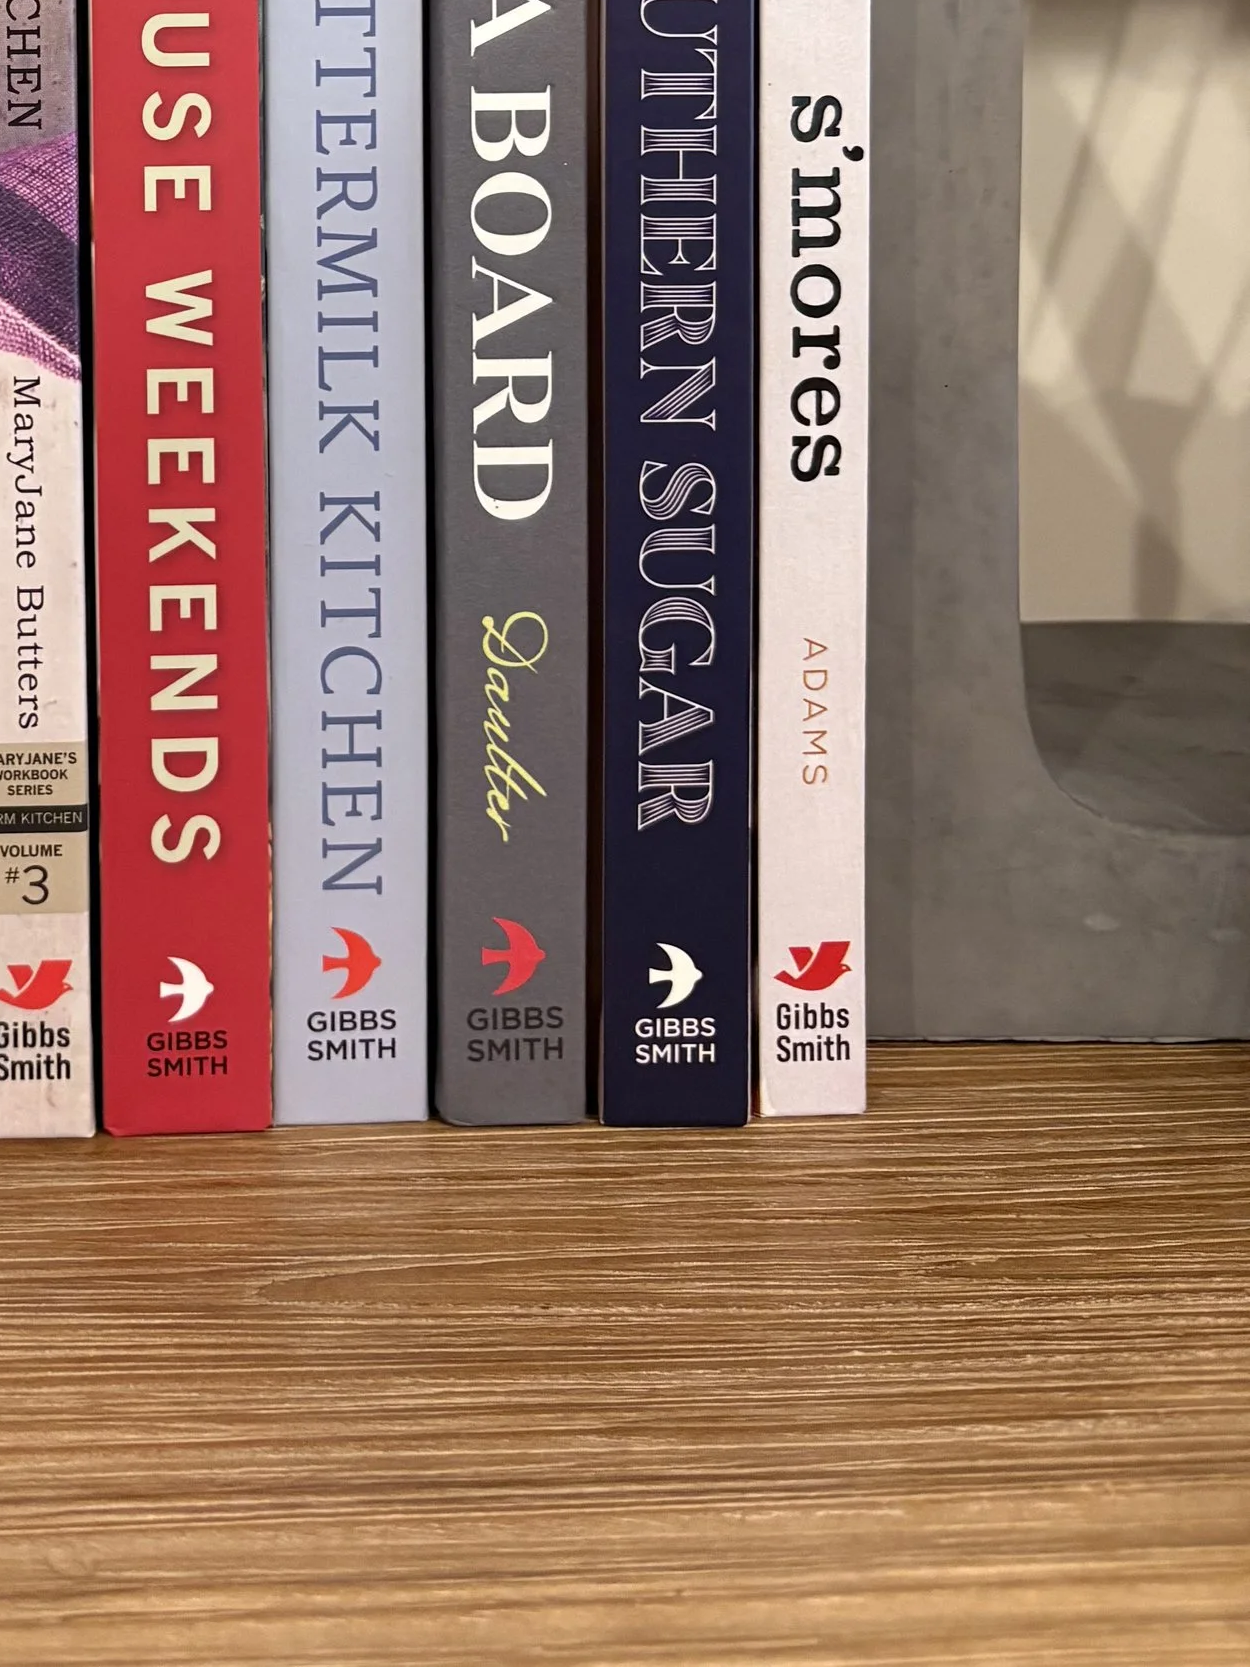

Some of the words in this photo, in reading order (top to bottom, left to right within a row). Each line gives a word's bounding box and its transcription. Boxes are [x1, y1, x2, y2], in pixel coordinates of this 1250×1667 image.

[470, 85, 553, 520] BOARD
[7, 376, 44, 568] MaryJane
[145, 269, 220, 863] WEEKENDS
[15, 585, 44, 730] Butters
[637, 460, 715, 831] SUGAR
[319, 491, 383, 895] KITCHEN
[801, 638, 827, 785] ADAMS
[7, 784, 53, 796] SERIES
[21, 811, 83, 825] KITCHEN
[0, 844, 62, 857] VOLUME
[307, 1009, 396, 1031] GIBBS
[467, 1006, 563, 1031] GIBBS
[635, 1017, 715, 1037] GIBBS
[776, 1003, 849, 1030] Gibbs
[147, 1030, 228, 1051] GIBBS
[307, 1037, 396, 1061] SMITH
[467, 1037, 563, 1062] SMITH
[635, 1043, 715, 1063] SMITH
[776, 1035, 850, 1061] Smith
[147, 1056, 228, 1077] SMITH
